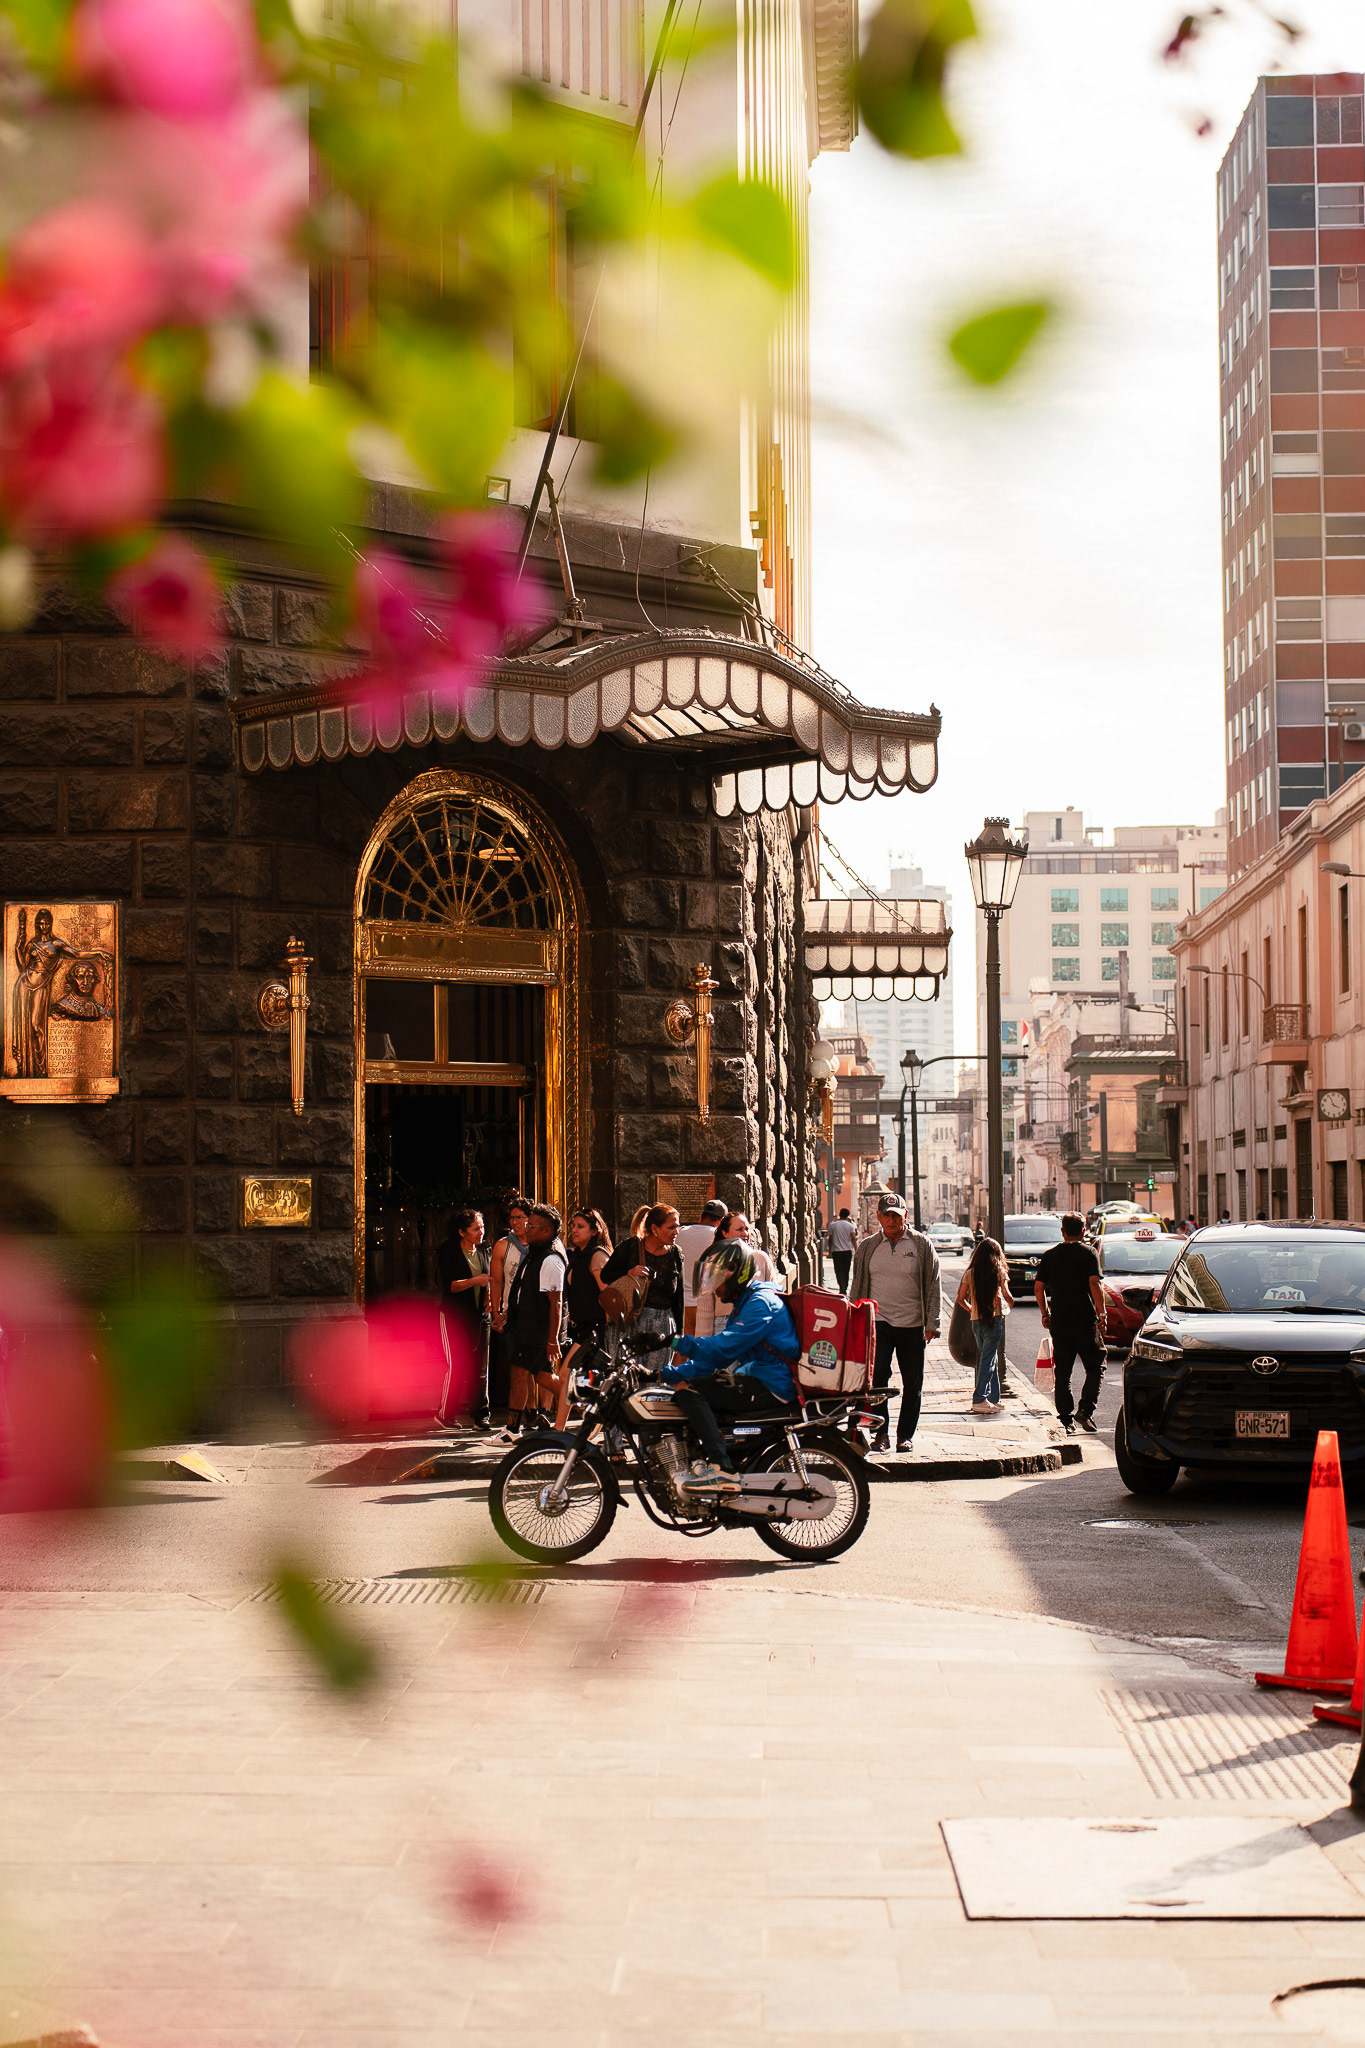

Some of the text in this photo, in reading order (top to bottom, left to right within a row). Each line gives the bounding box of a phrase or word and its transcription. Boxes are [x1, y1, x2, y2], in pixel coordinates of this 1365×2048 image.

[1271, 1290, 1301, 1300] TAXI
[812, 1308, 838, 1332] P
[1238, 1419, 1287, 1434] CNR-571
